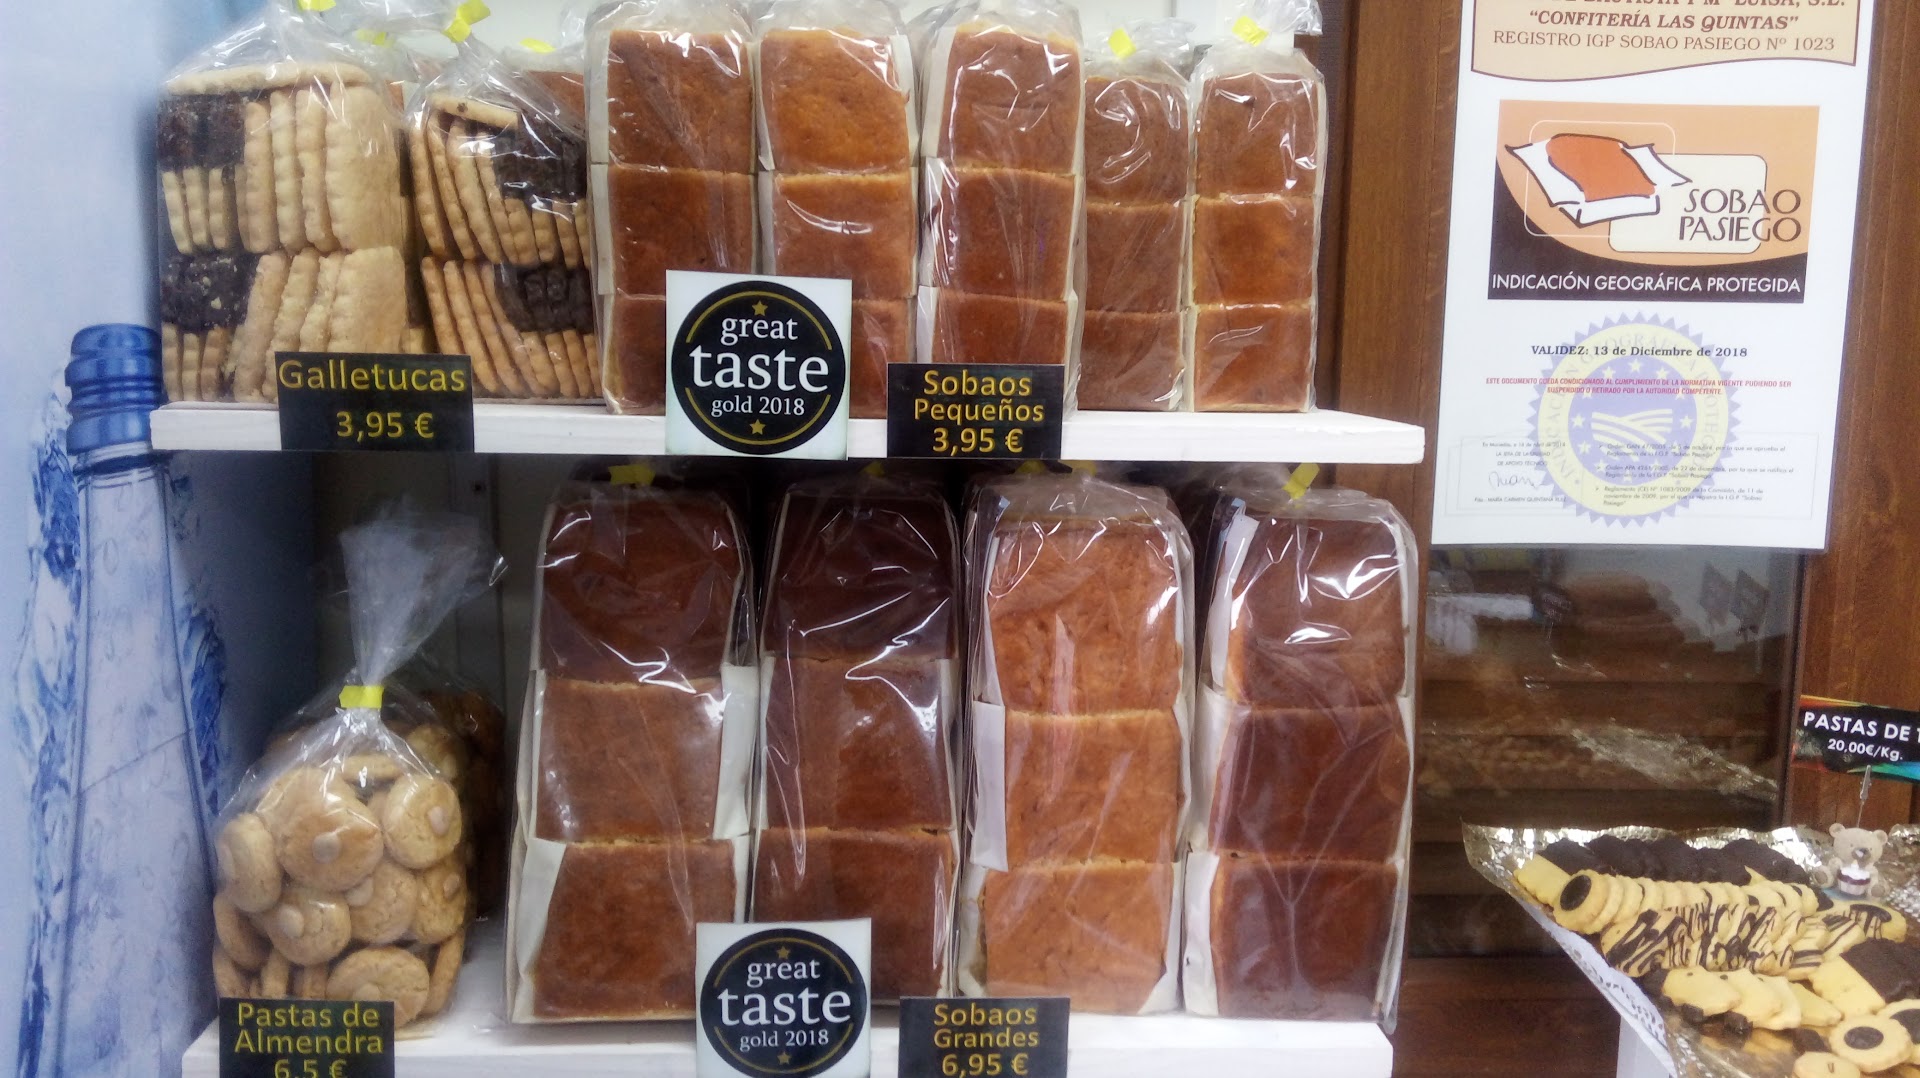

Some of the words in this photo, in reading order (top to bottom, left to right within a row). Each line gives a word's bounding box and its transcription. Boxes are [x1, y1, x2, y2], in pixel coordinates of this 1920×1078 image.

[1657, 15, 1694, 28] LAS
[1494, 30, 1581, 46] REGISTRO
[1587, 33, 1614, 47] IGP
[1620, 35, 1678, 49] SOBAO
[1684, 36, 1760, 50] PASIEGO
[1767, 37, 1786, 50] Nº
[1795, 38, 1834, 50] 1023
[1684, 189, 1801, 214] SOBAO
[1679, 216, 1801, 242] PASIEGO
[1492, 271, 1590, 290] INDICACIÓN
[1594, 272, 1701, 292] GEOGRÁFICA
[1707, 277, 1800, 293] PROTEGIDA
[720, 317, 798, 346] great
[1531, 346, 1589, 355] VALIDEZ:
[1594, 346, 1608, 355] 13
[1612, 346, 1626, 355] de
[1630, 346, 1692, 356] Diciembre
[1697, 347, 1711, 357] de
[1716, 348, 1747, 357] 2018
[278, 359, 465, 391] Galletucas
[689, 345, 829, 393] taste
[923, 369, 1032, 396] Sobaos
[1718, 379, 1742, 387] VIGENTE
[711, 395, 752, 417] gold
[759, 397, 804, 415] 2018
[914, 398, 1044, 425] Pequeños
[336, 411, 405, 443] 3,95
[414, 412, 434, 438] €
[932, 428, 996, 456] 3,95
[1004, 428, 1023, 453] €
[1803, 711, 1877, 737] PASTAS
[1884, 723, 1911, 742] DE
[1828, 738, 1903, 761] 20,00€/Kg.
[746, 959, 820, 988] great
[238, 1002, 332, 1027] Pastas
[343, 1003, 380, 1028] de
[717, 987, 851, 1026] taste
[934, 1002, 1037, 1026] Sobaos
[234, 1028, 383, 1054] Almendra
[739, 1031, 779, 1052] gold
[786, 1030, 829, 1047] 2018
[934, 1027, 1039, 1049] Grandes
[329, 1058, 348, 1078] €
[942, 1053, 1003, 1078] 6,95
[1011, 1053, 1029, 1076] €
